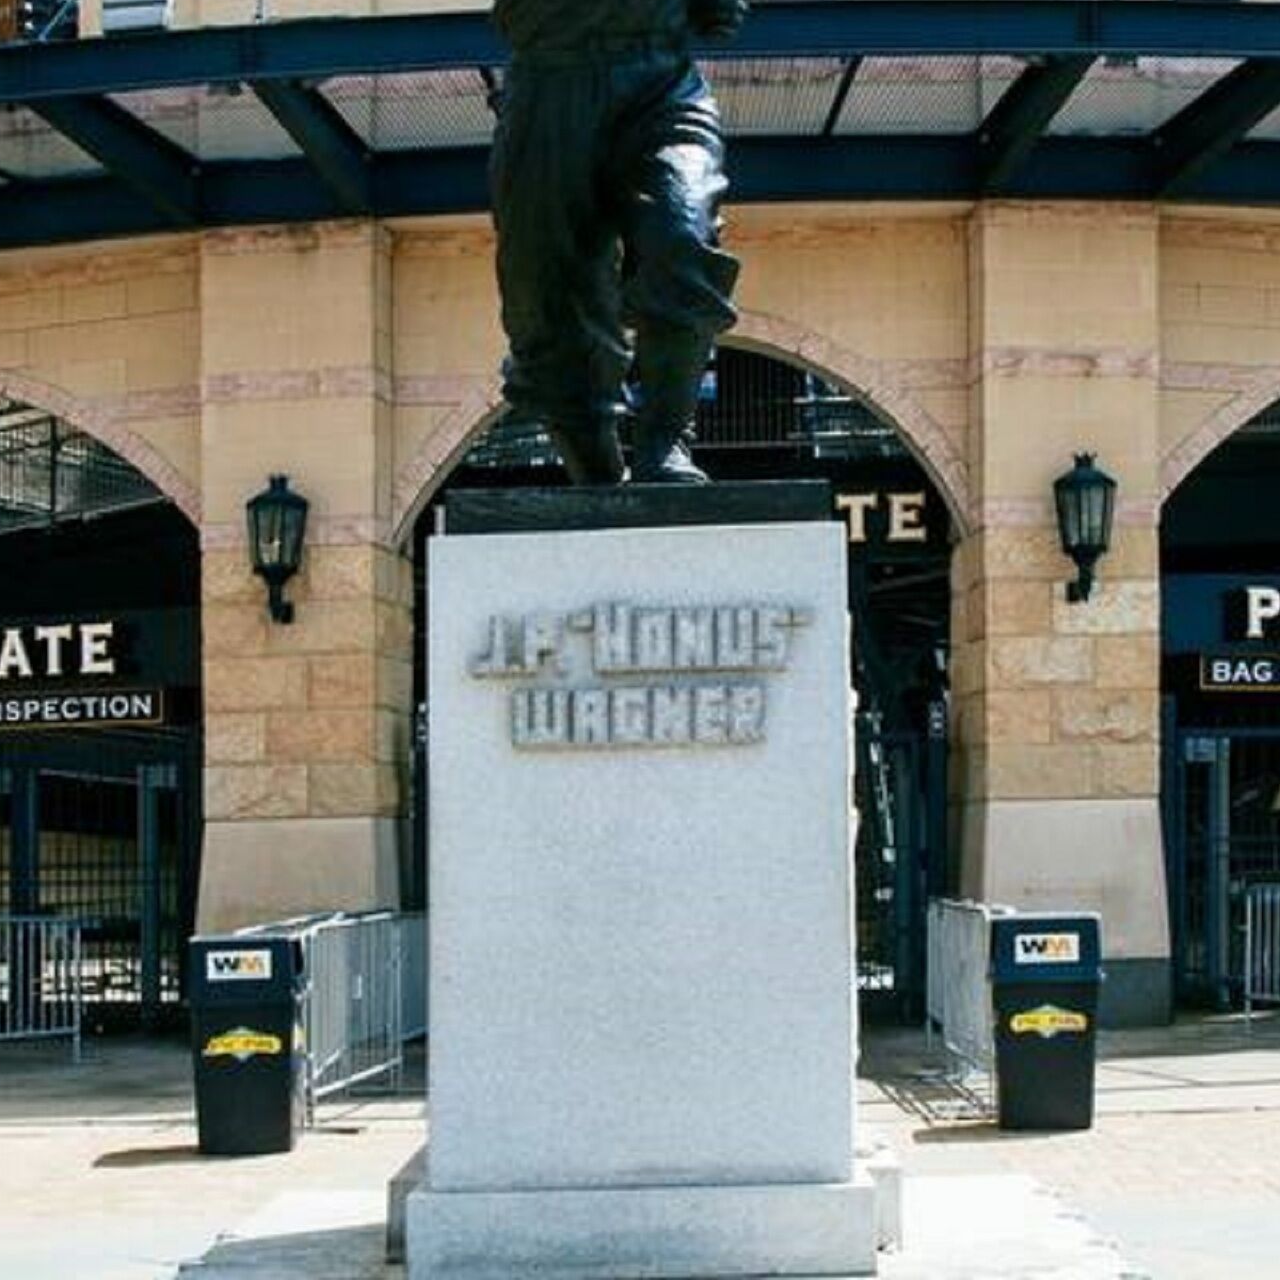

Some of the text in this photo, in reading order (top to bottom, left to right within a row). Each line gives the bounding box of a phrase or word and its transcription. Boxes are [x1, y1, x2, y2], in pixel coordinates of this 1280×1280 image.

[834, 492, 927, 541] TE
[1211, 661, 1272, 683] BAG
[510, 682, 768, 751] WAGNER
[1021, 939, 1072, 954] WM
